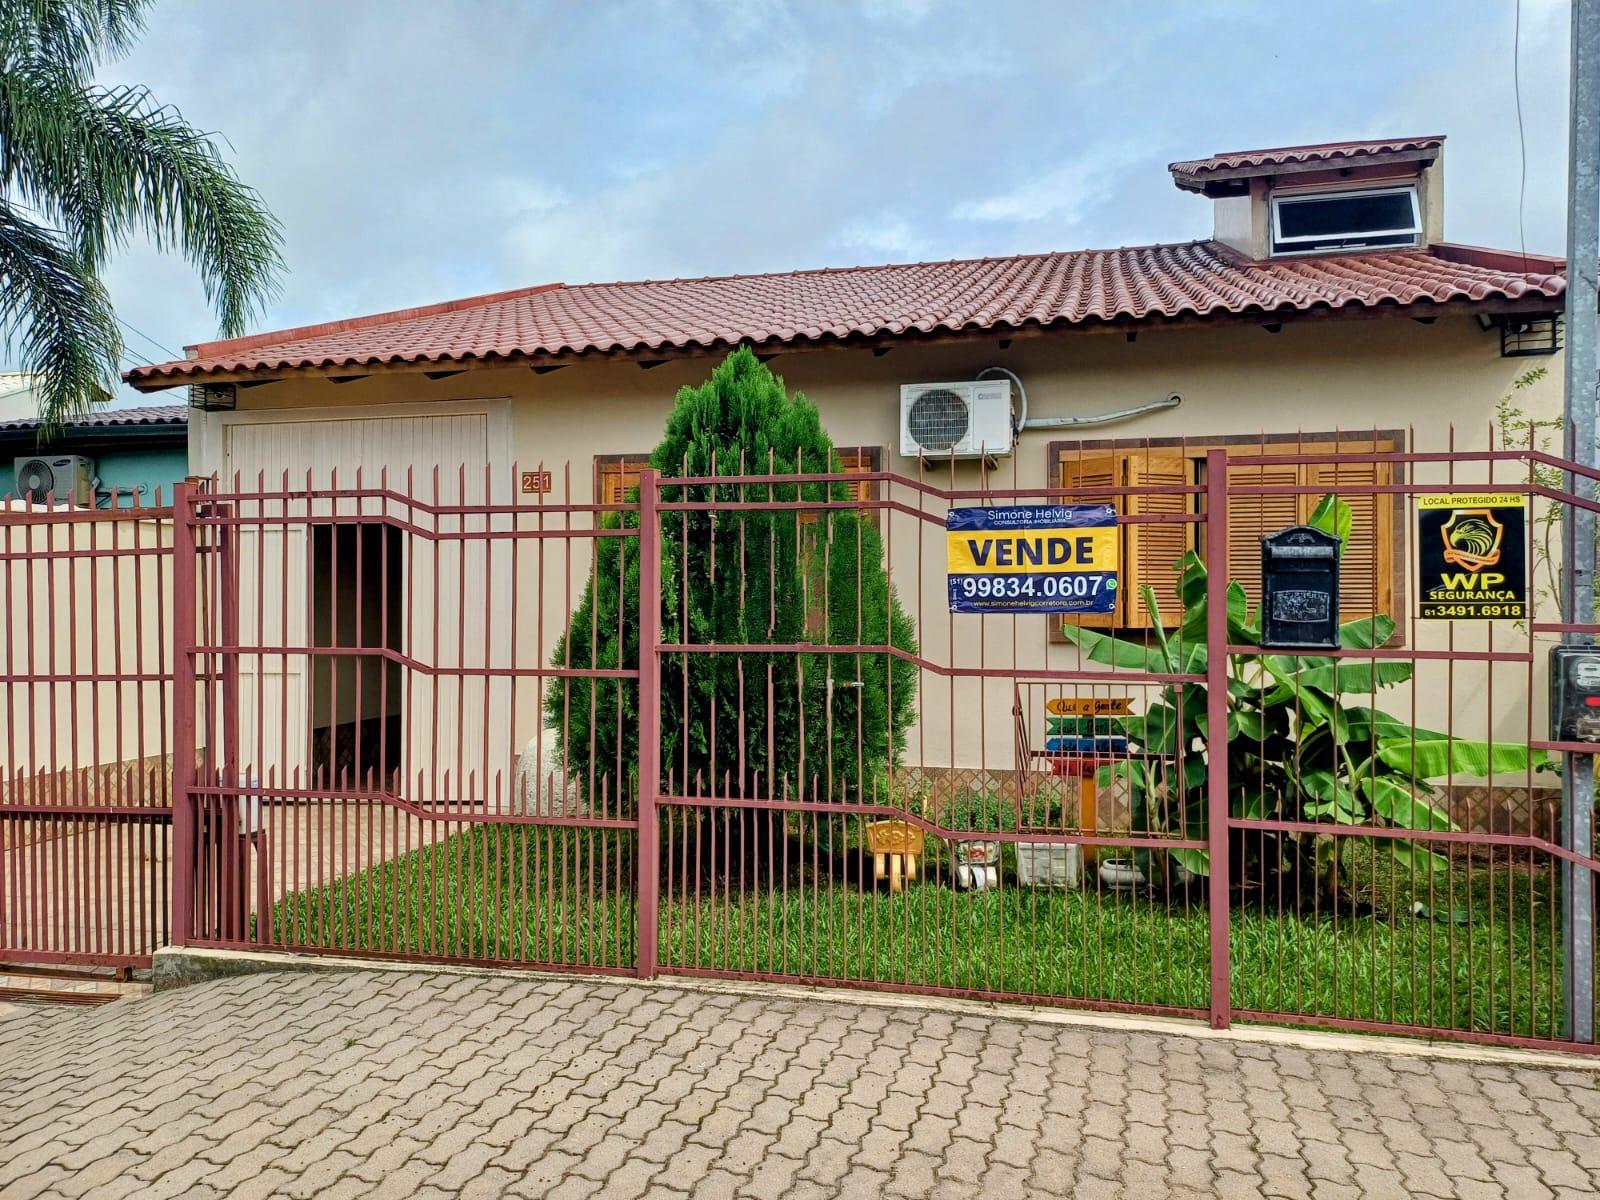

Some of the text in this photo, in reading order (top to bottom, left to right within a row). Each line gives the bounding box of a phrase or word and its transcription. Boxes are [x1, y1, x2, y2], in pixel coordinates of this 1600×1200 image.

[523, 475, 549, 489] 251
[1451, 496, 1498, 504] PROTEGIDO
[1509, 495, 1521, 503] HS
[988, 508, 1073, 520] Simone Helvig
[967, 536, 1094, 566] VENDE
[950, 578, 963, 586] (51)
[963, 576, 1103, 597] 99834.0607
[1440, 573, 1505, 590] WP
[1429, 590, 1515, 601] SEGURANÇA
[1424, 605, 1521, 616] 51 3491.6918
